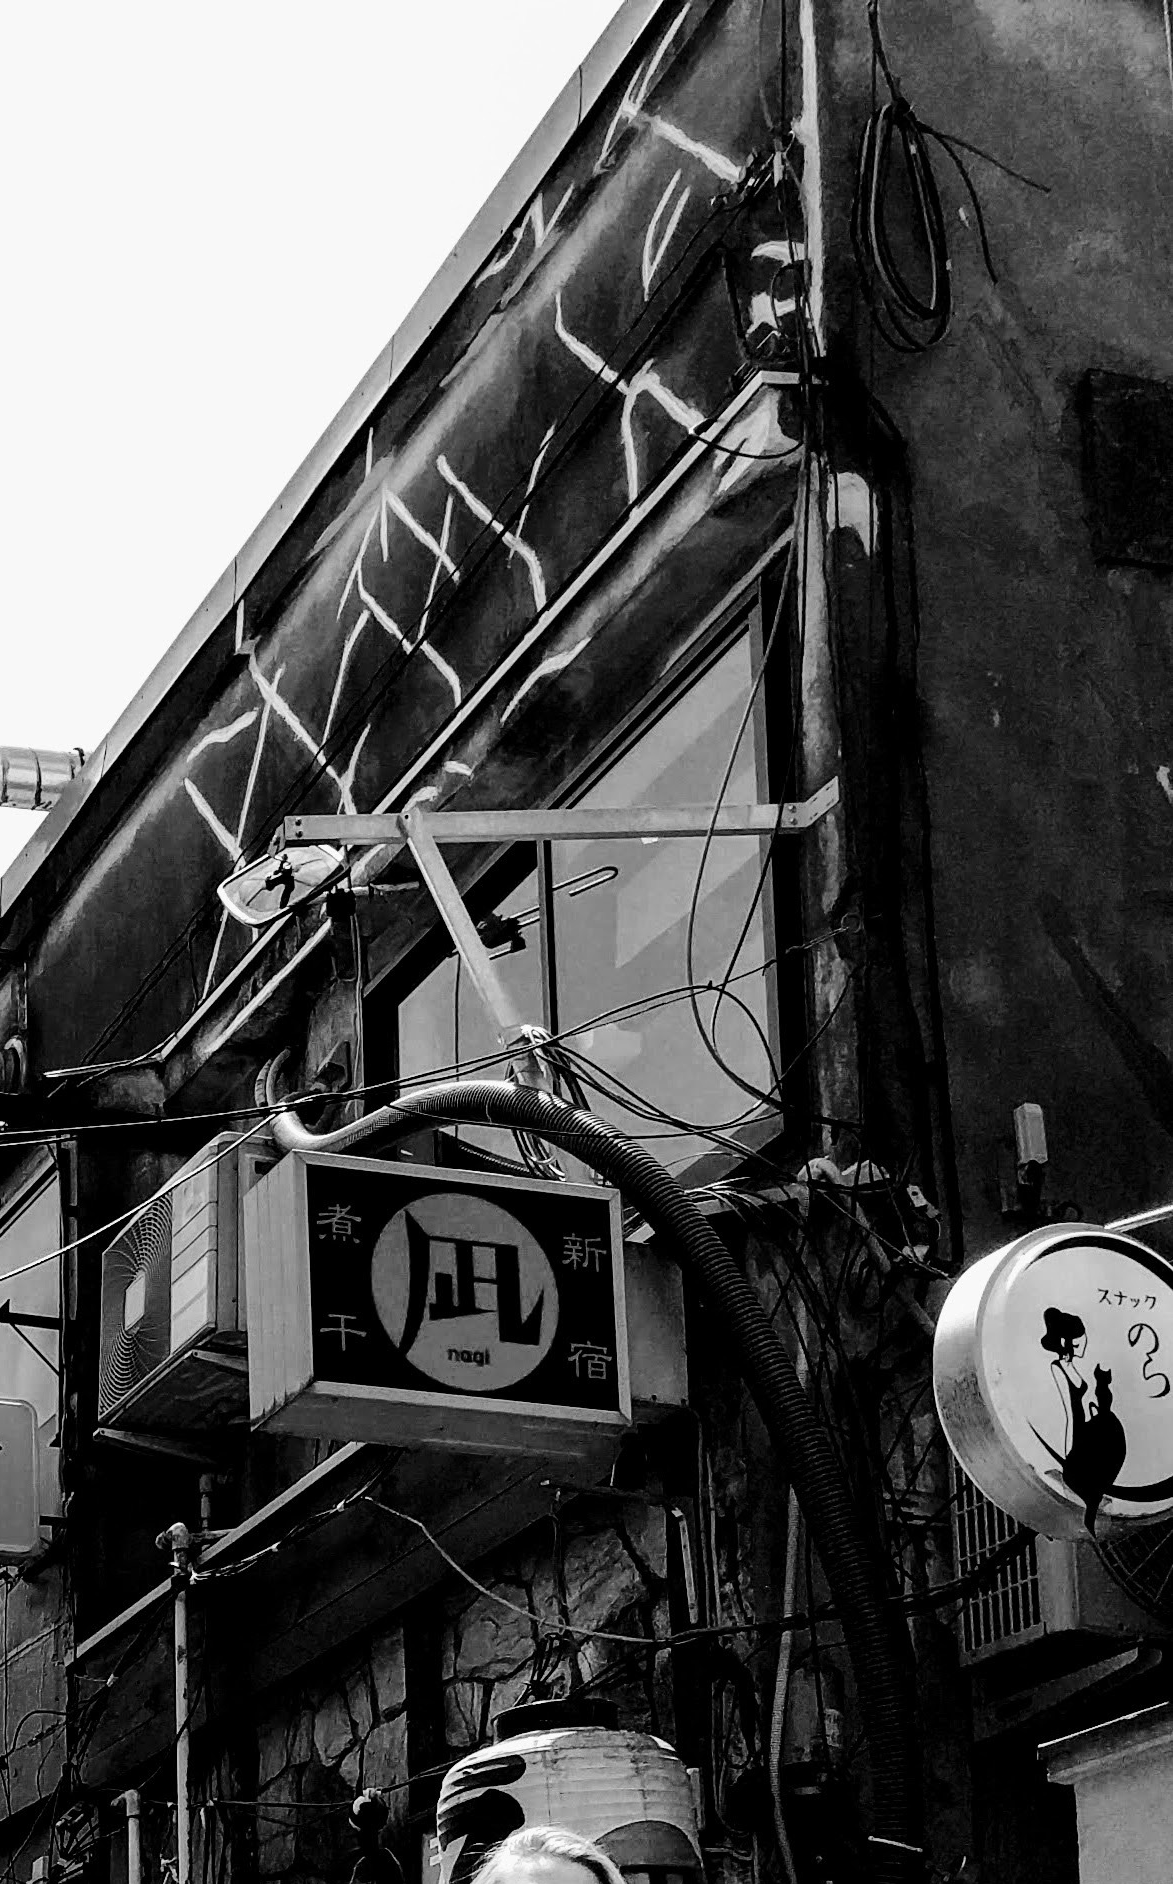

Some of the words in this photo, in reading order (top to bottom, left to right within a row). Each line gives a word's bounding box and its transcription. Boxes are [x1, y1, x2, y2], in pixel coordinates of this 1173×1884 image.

[562, 1232, 613, 1380] 新宿
[1097, 1288, 1157, 1310] スナック
[447, 1347, 491, 1367] nagi
[1128, 1323, 1171, 1399] のら
